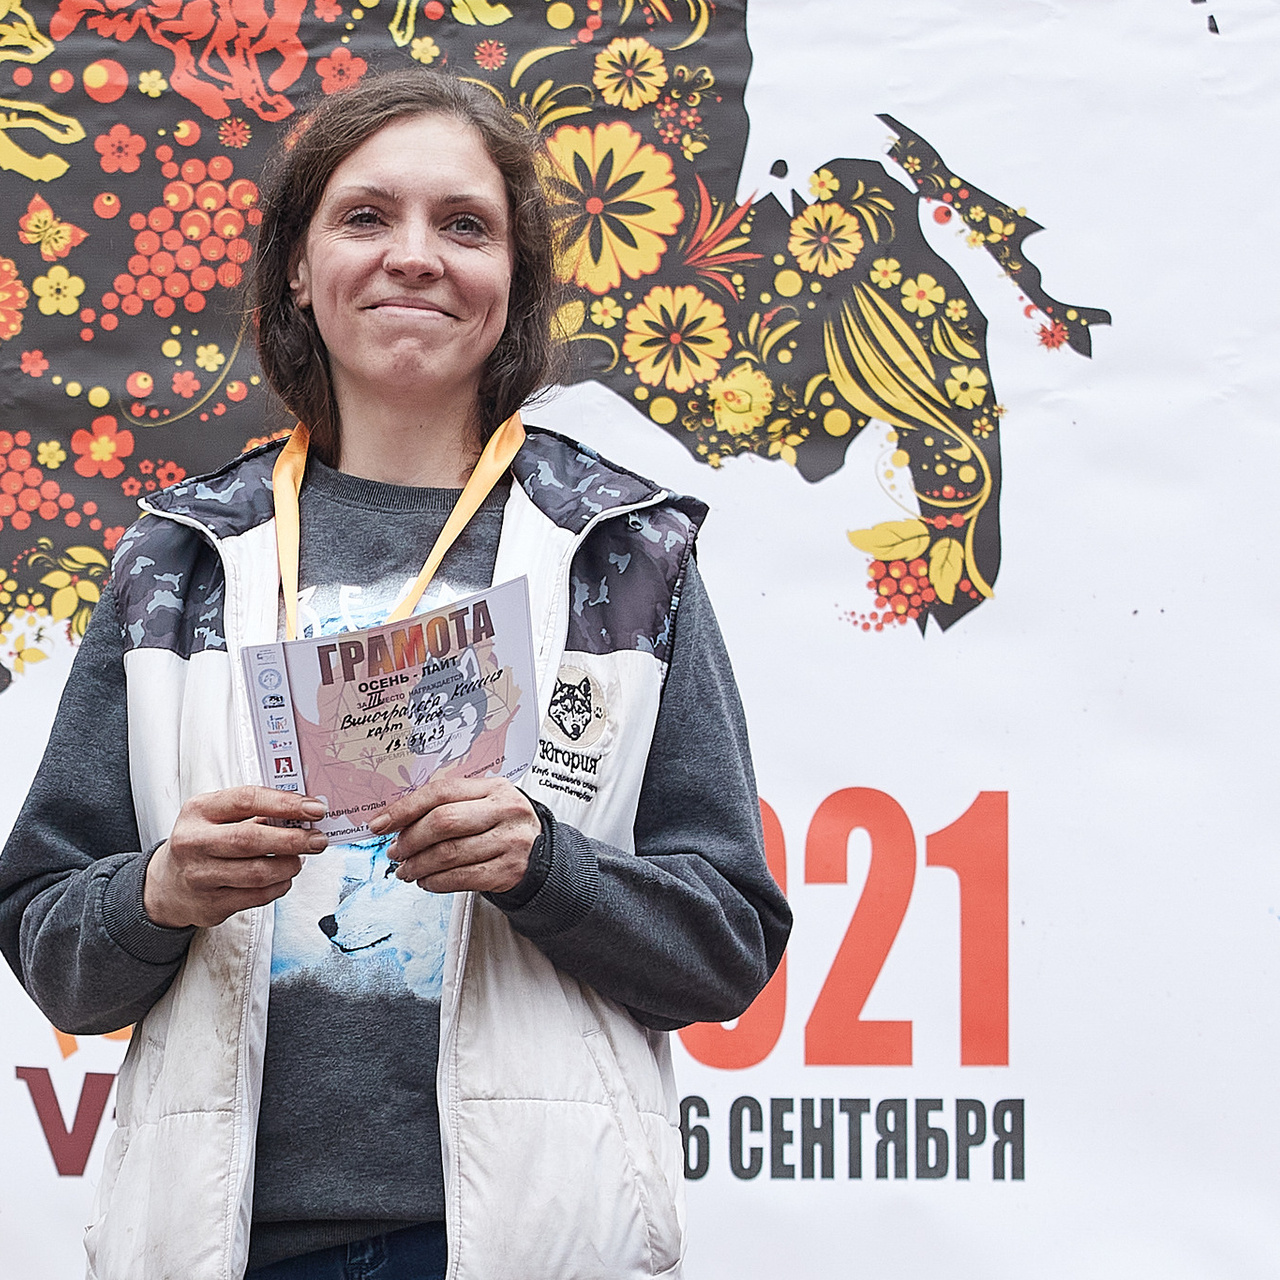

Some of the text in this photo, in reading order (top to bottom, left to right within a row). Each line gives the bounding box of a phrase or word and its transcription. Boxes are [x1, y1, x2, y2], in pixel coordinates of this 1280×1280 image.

[317, 600, 495, 686] ГРАМОТА
[358, 675, 410, 693] ОСЕНЬ
[422, 655, 458, 678] ЛАЙТ
[409, 674, 464, 696] НАГРАЖДАЕТСЯ
[325, 800, 387, 819] ЛАВНЫЙ СУДЬЯ
[325, 827, 365, 838] ЕМПИОНАТ
[728, 1095, 1026, 1181] СЕНТЯБРЯ
